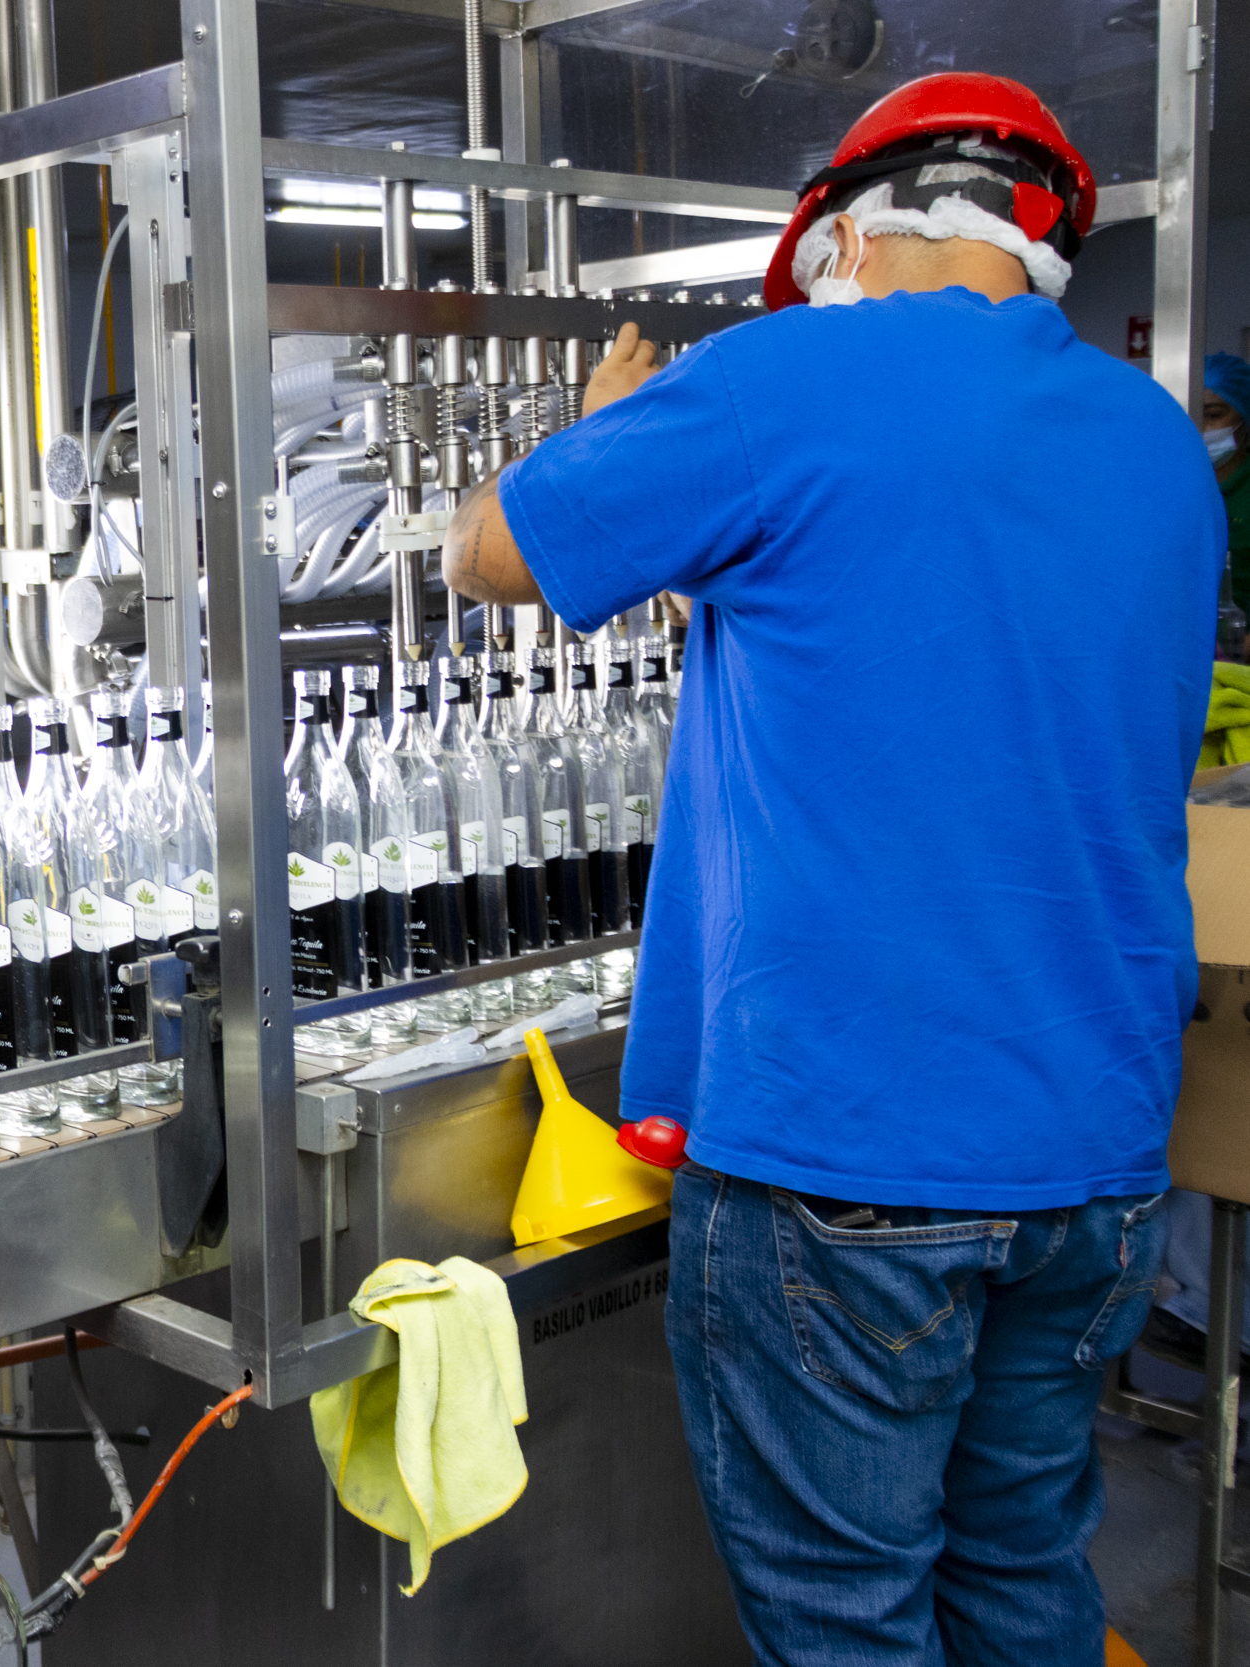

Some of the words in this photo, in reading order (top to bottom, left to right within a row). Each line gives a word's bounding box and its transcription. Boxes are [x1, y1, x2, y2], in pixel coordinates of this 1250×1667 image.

[291, 892, 312, 900] QUILA
[298, 937, 324, 950] Tequila
[534, 1302, 585, 1344] BASILIO
[589, 1279, 640, 1321] VADILLO
